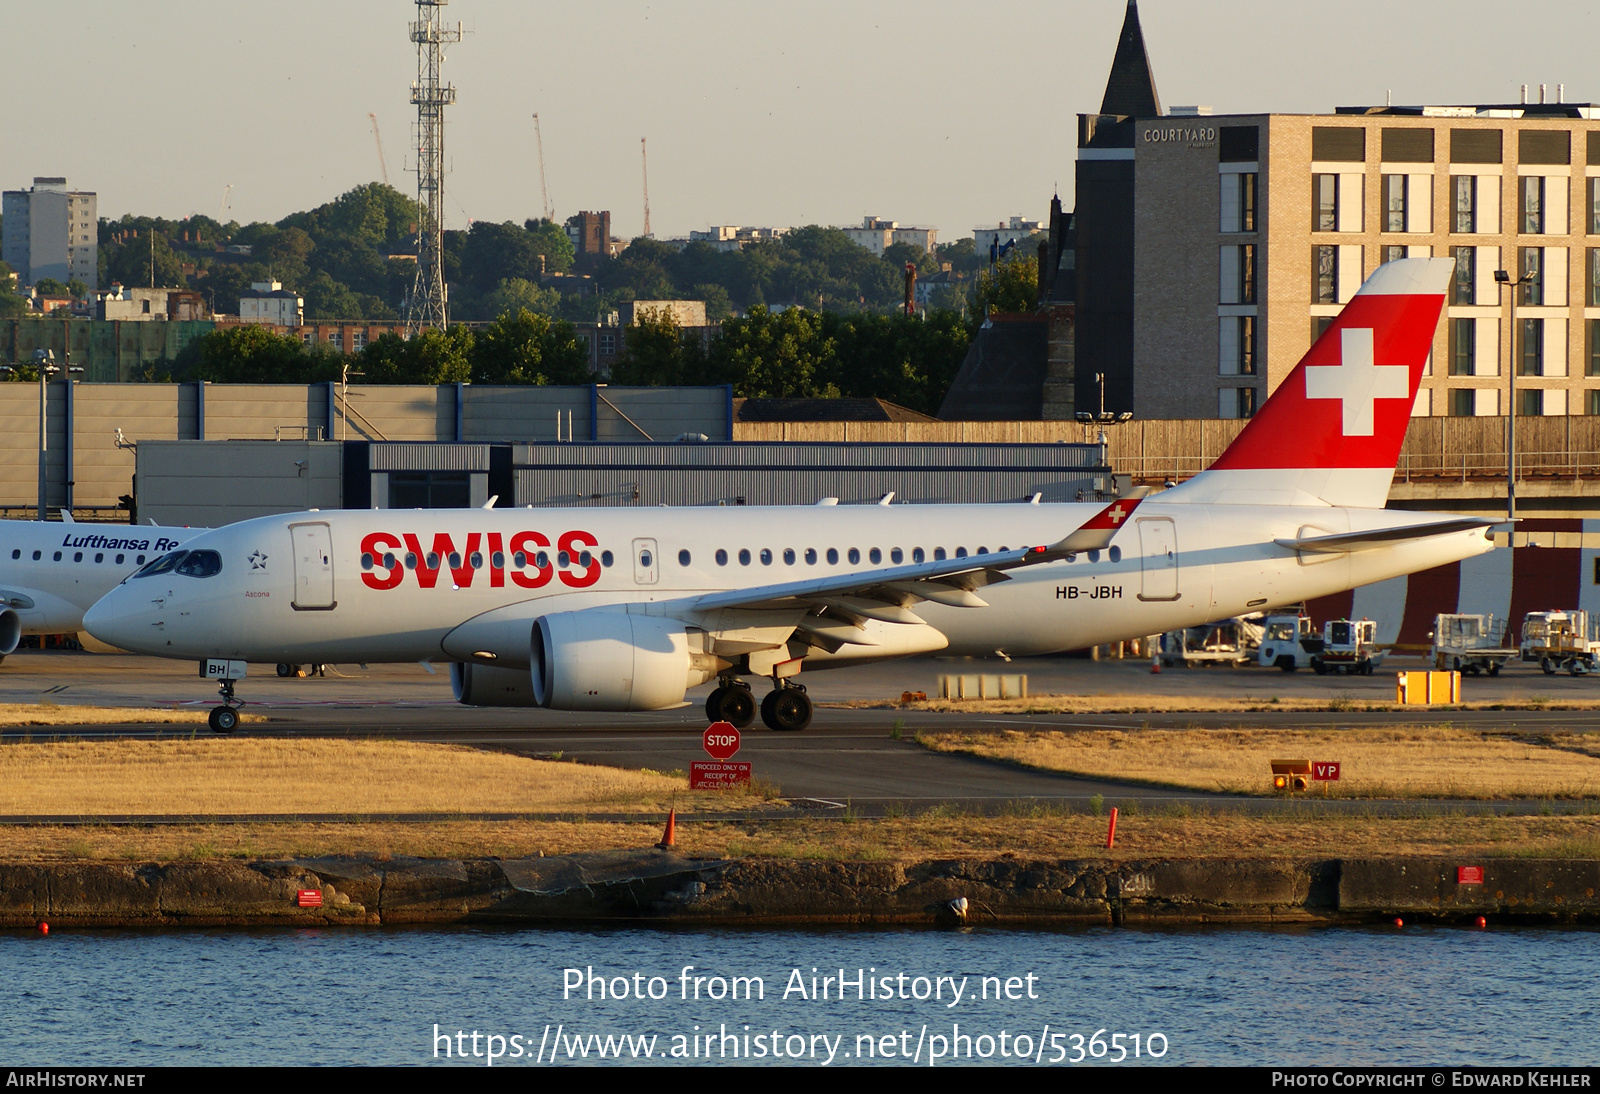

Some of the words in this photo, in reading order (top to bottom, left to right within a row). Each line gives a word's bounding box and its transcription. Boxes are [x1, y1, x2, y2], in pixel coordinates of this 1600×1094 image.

[1144, 128, 1215, 142] COURTYARD
[62, 533, 150, 551] Lufthansa
[360, 530, 602, 591] SWISS
[1056, 586, 1123, 599] HB-JBH
[208, 664, 226, 674] BH
[707, 735, 737, 746] STOP
